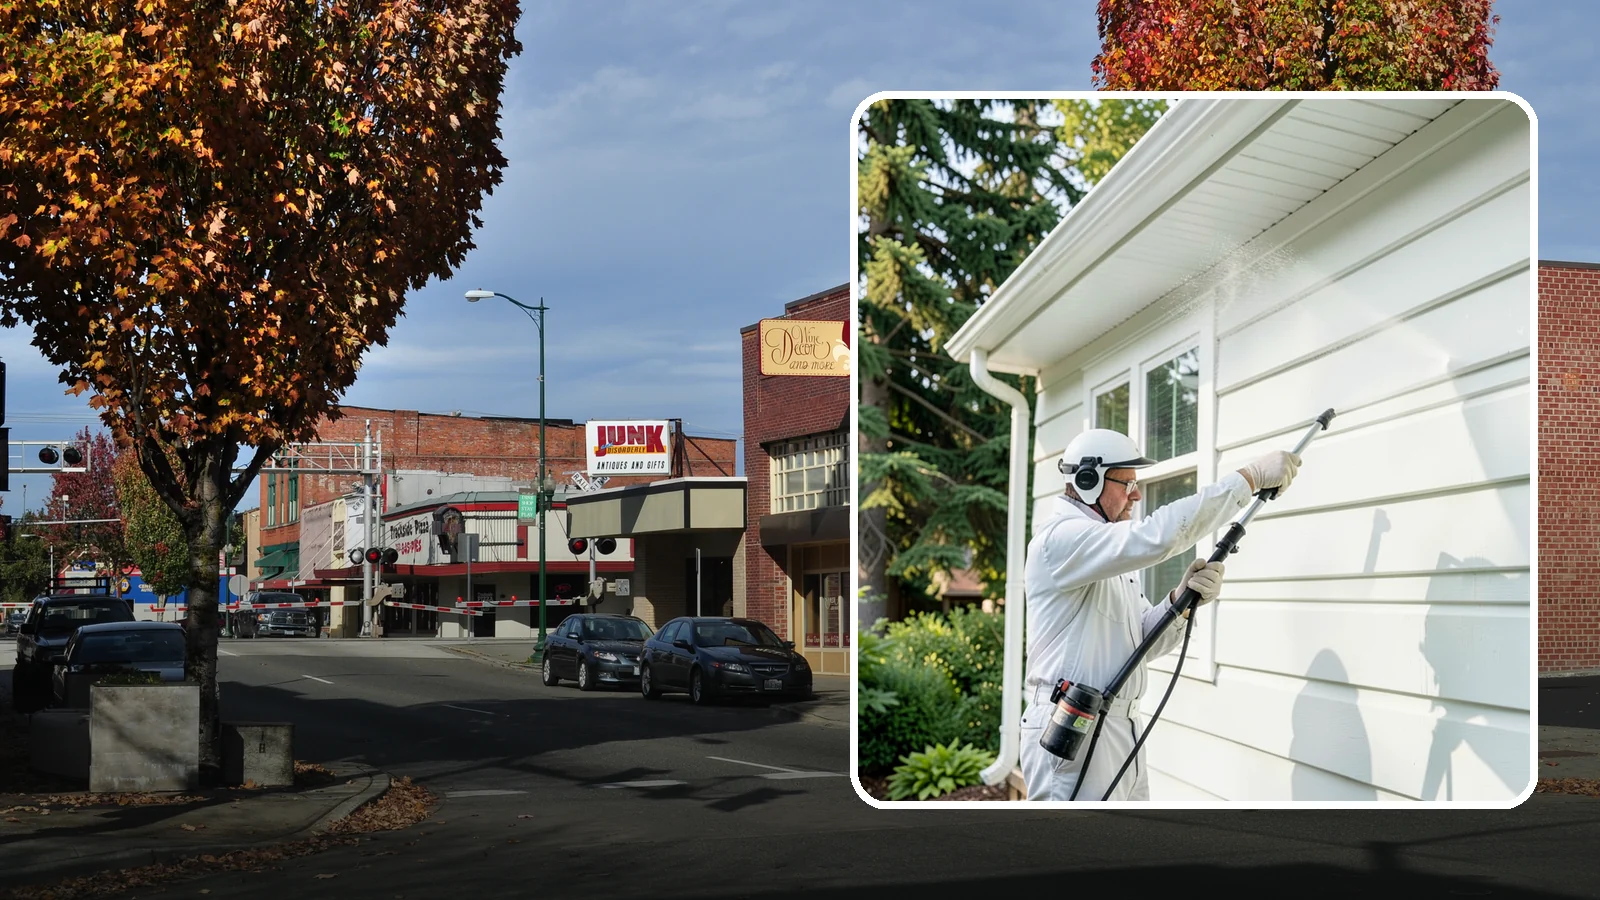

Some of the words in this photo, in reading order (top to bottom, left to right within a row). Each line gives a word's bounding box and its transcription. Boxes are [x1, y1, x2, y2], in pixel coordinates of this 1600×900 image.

[595, 425, 665, 457] JUNK
[607, 446, 646, 454] DISORDERLY
[597, 461, 628, 470] ANTIQUES
[631, 461, 644, 470] AND
[647, 460, 665, 469] GIFTS
[414, 519, 429, 535] Pizza
